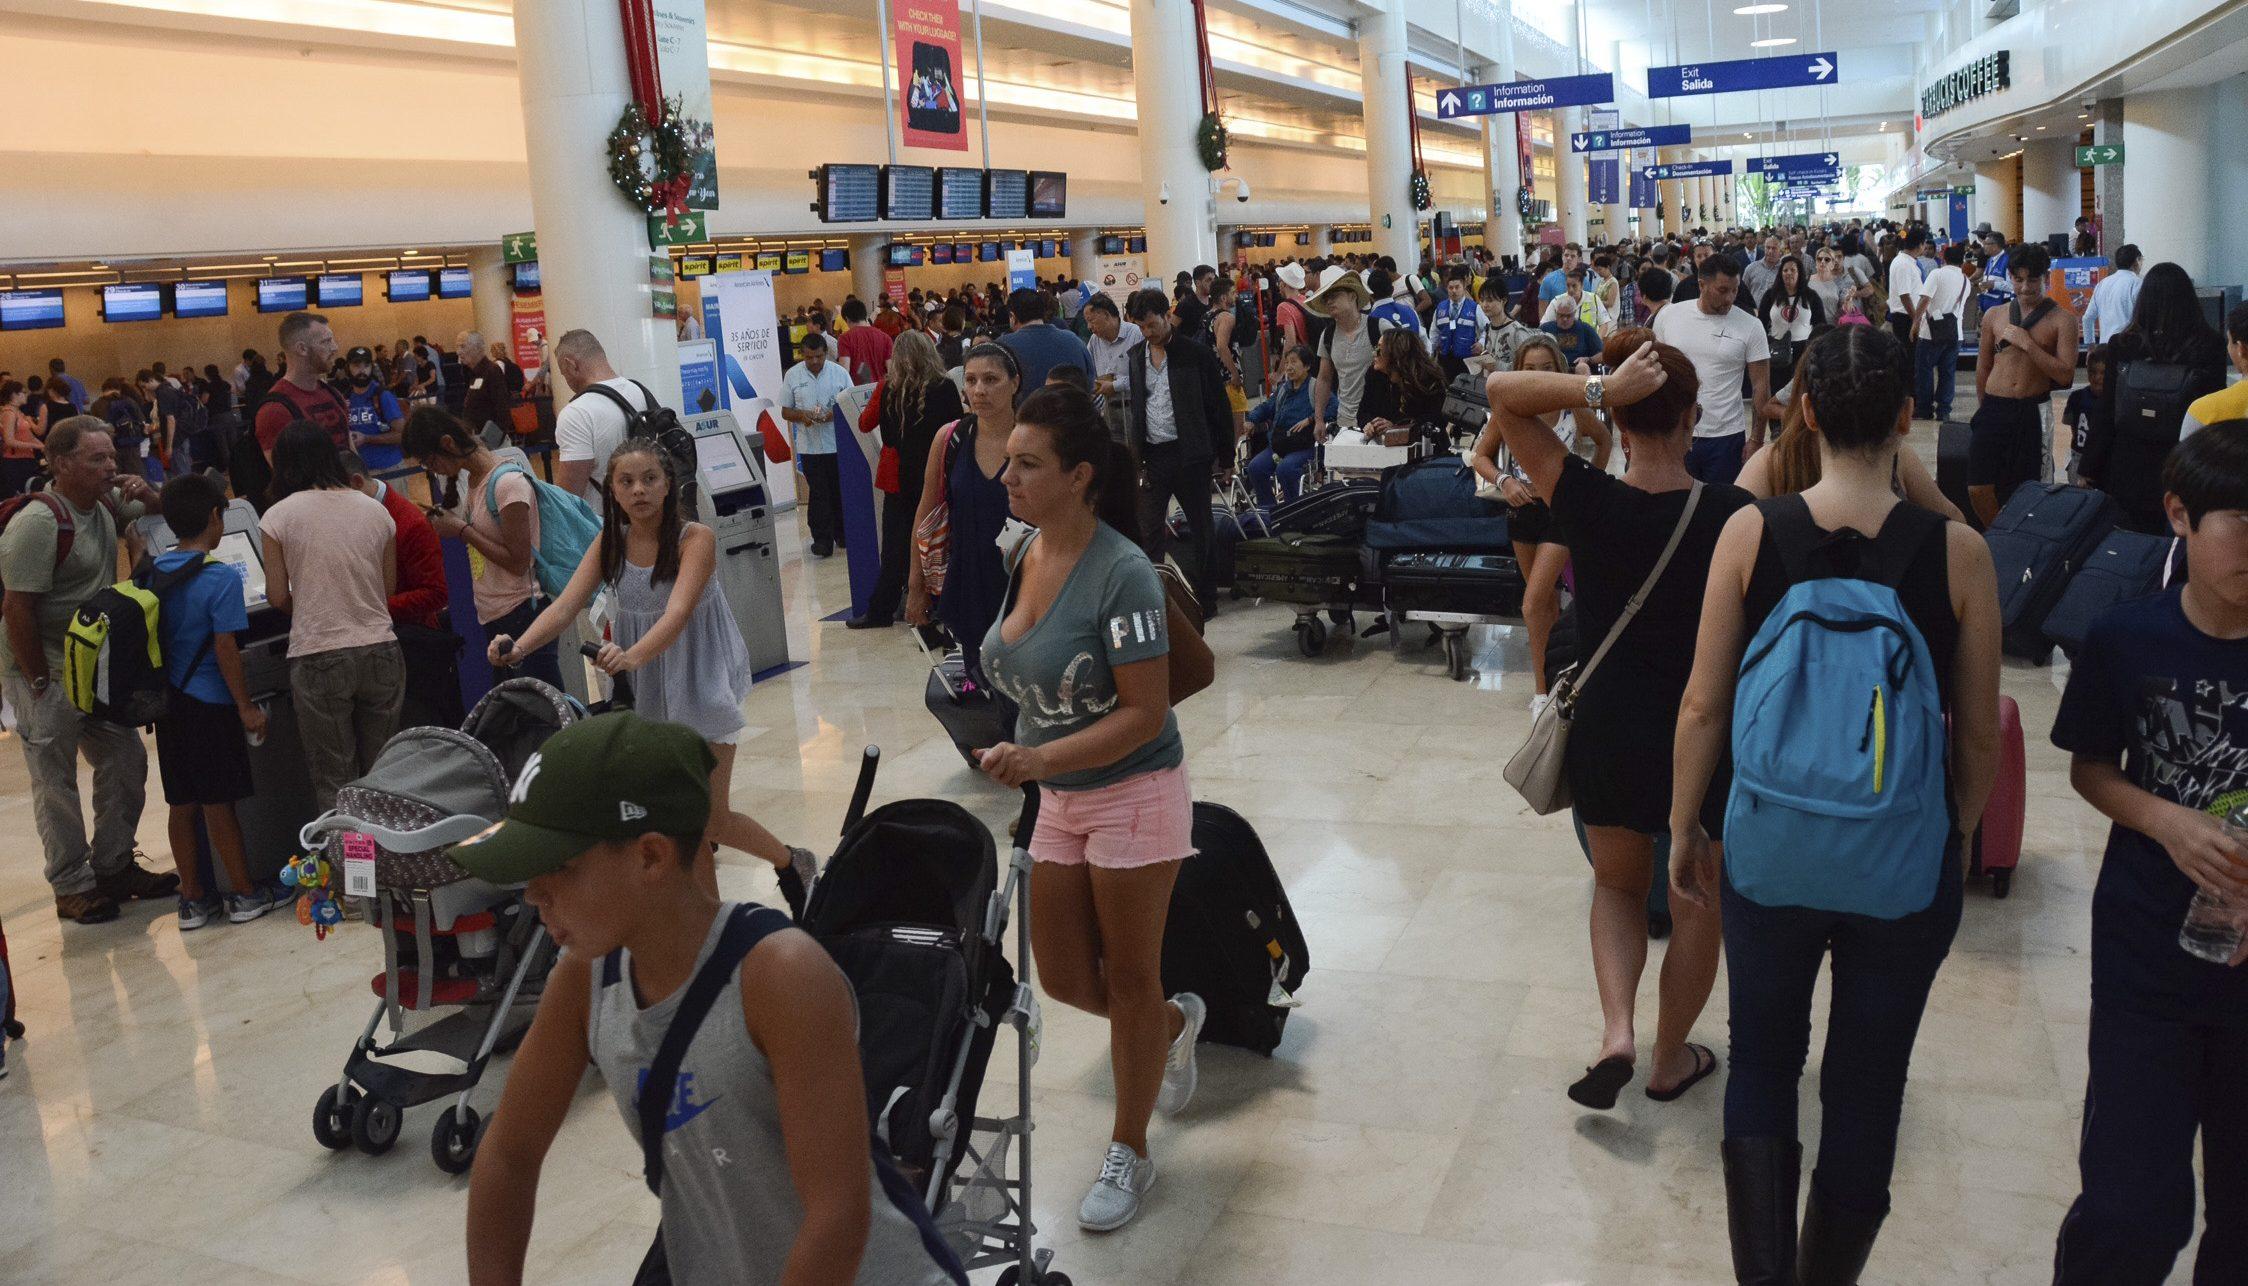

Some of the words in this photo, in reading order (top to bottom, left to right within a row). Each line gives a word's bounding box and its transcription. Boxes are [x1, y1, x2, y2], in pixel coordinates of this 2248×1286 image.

[908, 8, 928, 21] CHECK
[897, 20, 912, 33] WITH
[913, 23, 929, 36] YOUR
[1681, 67, 1700, 78] Exit
[1956, 52, 2005, 102] COFFEE
[1494, 83, 1545, 96] Information
[1681, 78, 1714, 91] Salida
[1494, 94, 1554, 109] Información
[1610, 130, 1646, 138] Information
[1610, 137, 1651, 147] Información
[1672, 168, 1713, 177] Documentación
[684, 260, 707, 270] spirit
[718, 260, 739, 270] spirit
[758, 258, 778, 268] spirit
[788, 255, 807, 266] spirit
[730, 332, 738, 342] 35
[740, 328, 759, 340] AÑOS
[761, 328, 770, 338] DE
[737, 340, 768, 352] SERVICIO
[696, 420, 719, 432] ASUR
